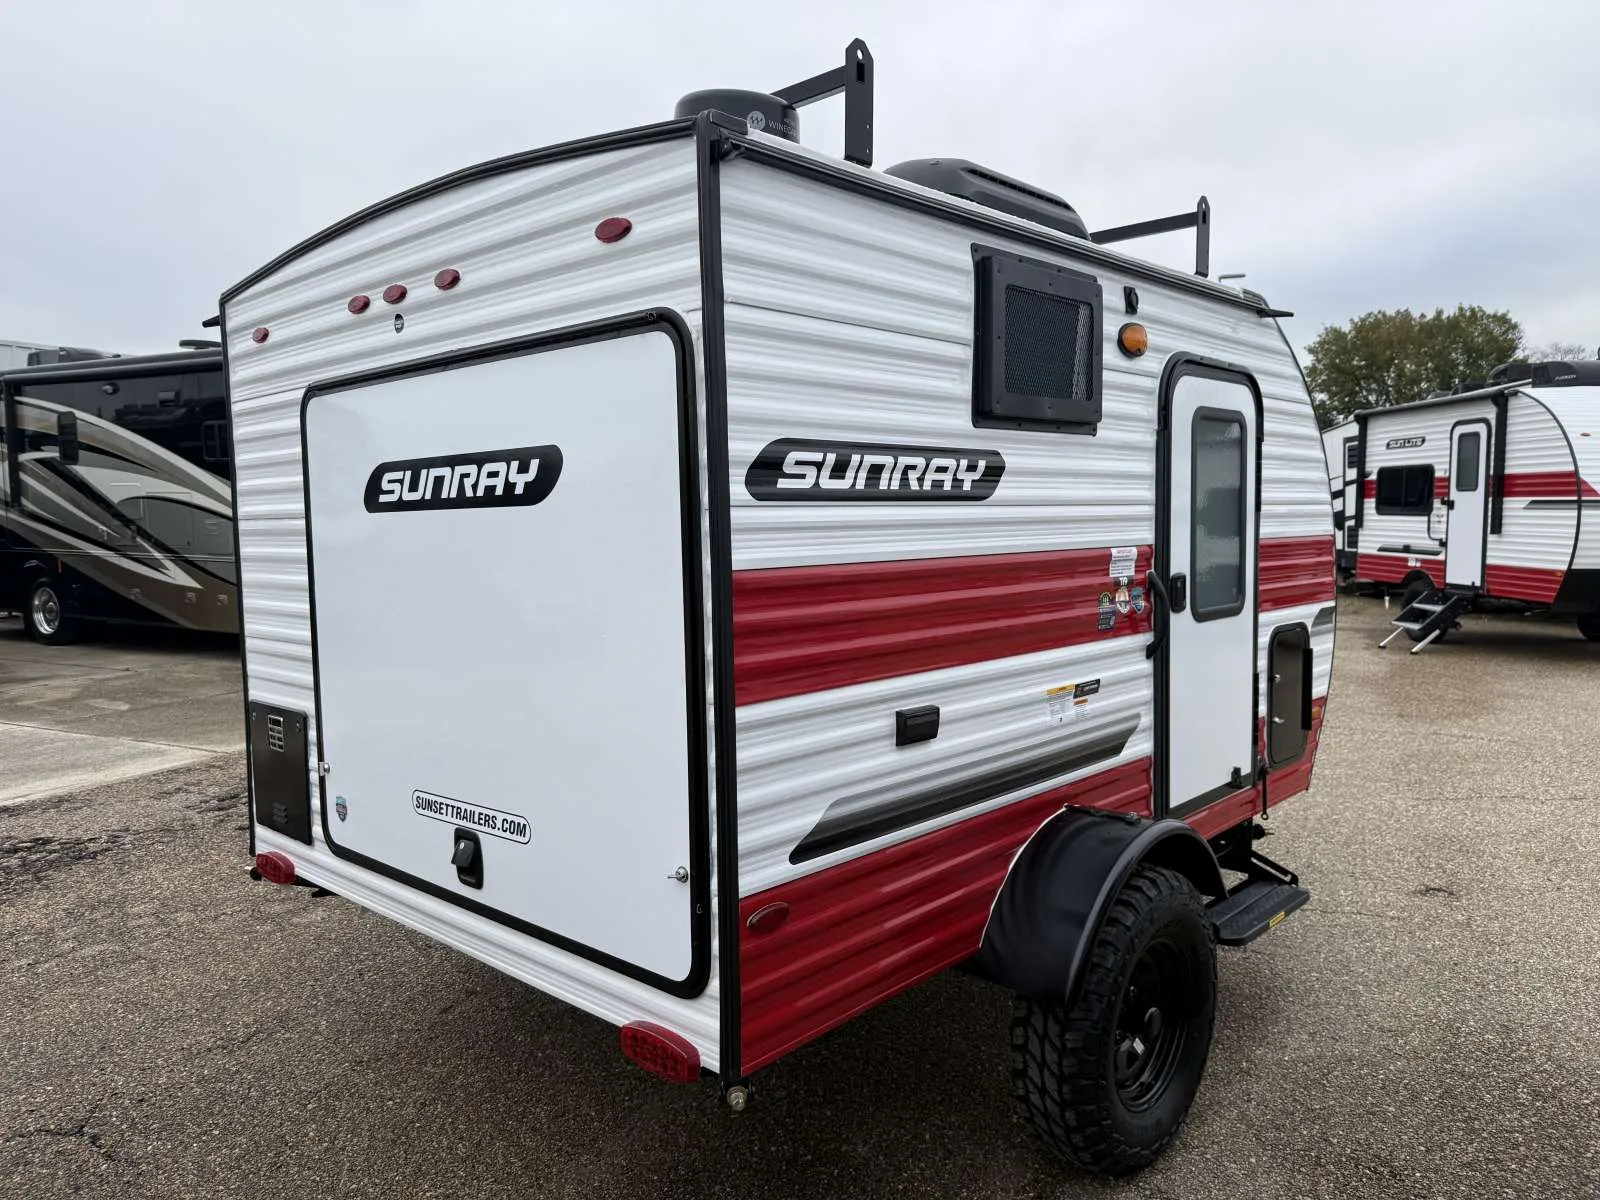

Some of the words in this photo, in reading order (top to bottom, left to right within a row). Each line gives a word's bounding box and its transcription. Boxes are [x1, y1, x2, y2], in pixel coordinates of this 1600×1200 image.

[378, 458, 540, 503] SUNRAY
[776, 451, 987, 491] SUNRAY
[415, 795, 527, 838] SUNSETTRAILERS.COM
